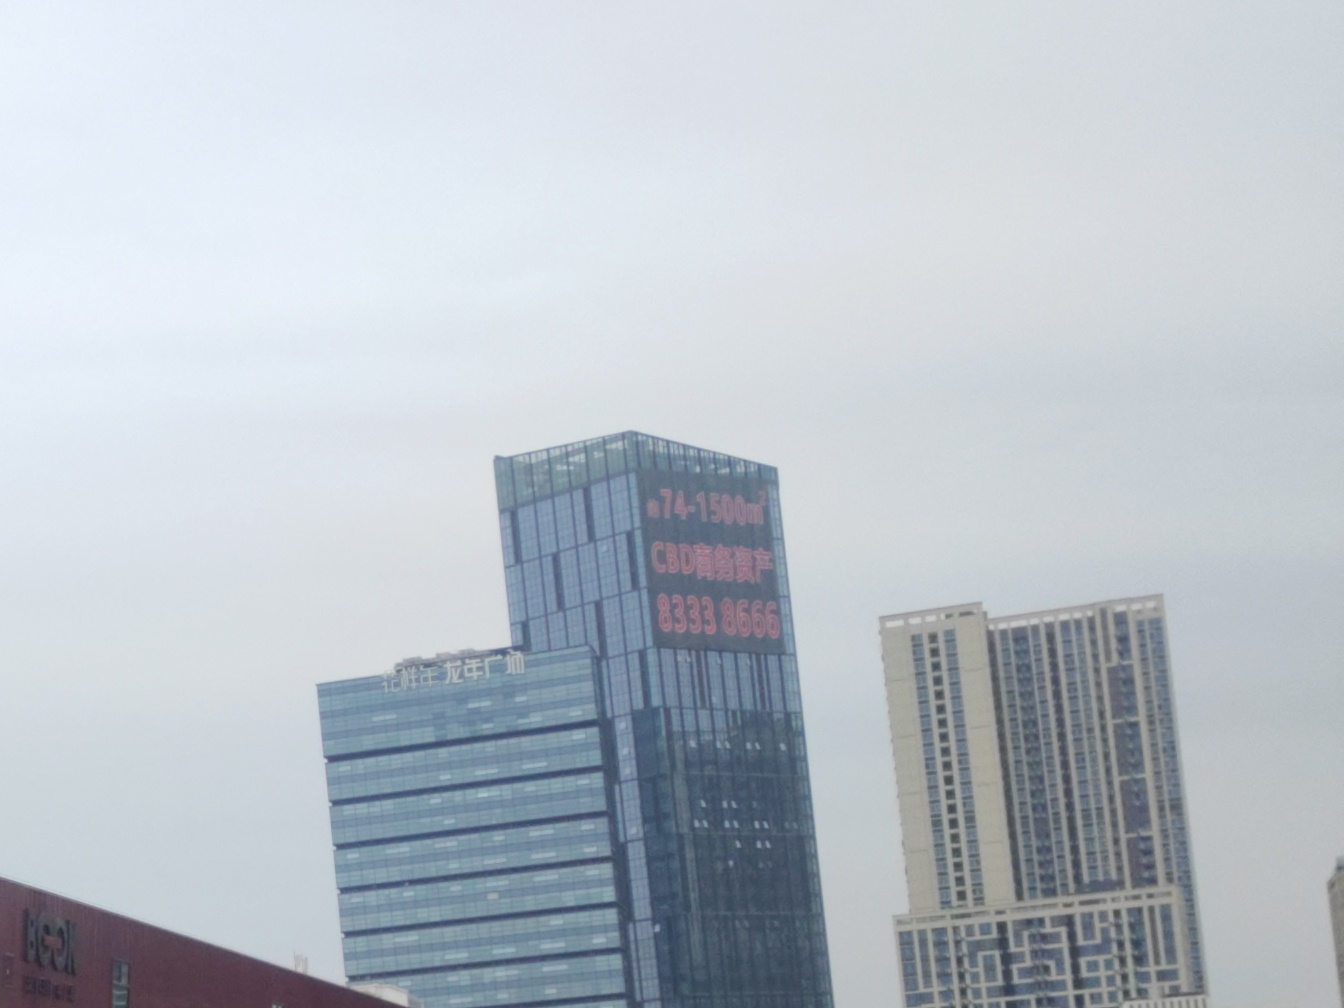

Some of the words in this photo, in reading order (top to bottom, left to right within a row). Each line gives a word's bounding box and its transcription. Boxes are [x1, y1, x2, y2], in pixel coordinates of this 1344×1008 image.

[651, 541, 774, 584] CBD商务资产
[657, 593, 717, 635] 8333
[720, 597, 780, 639] 8666
